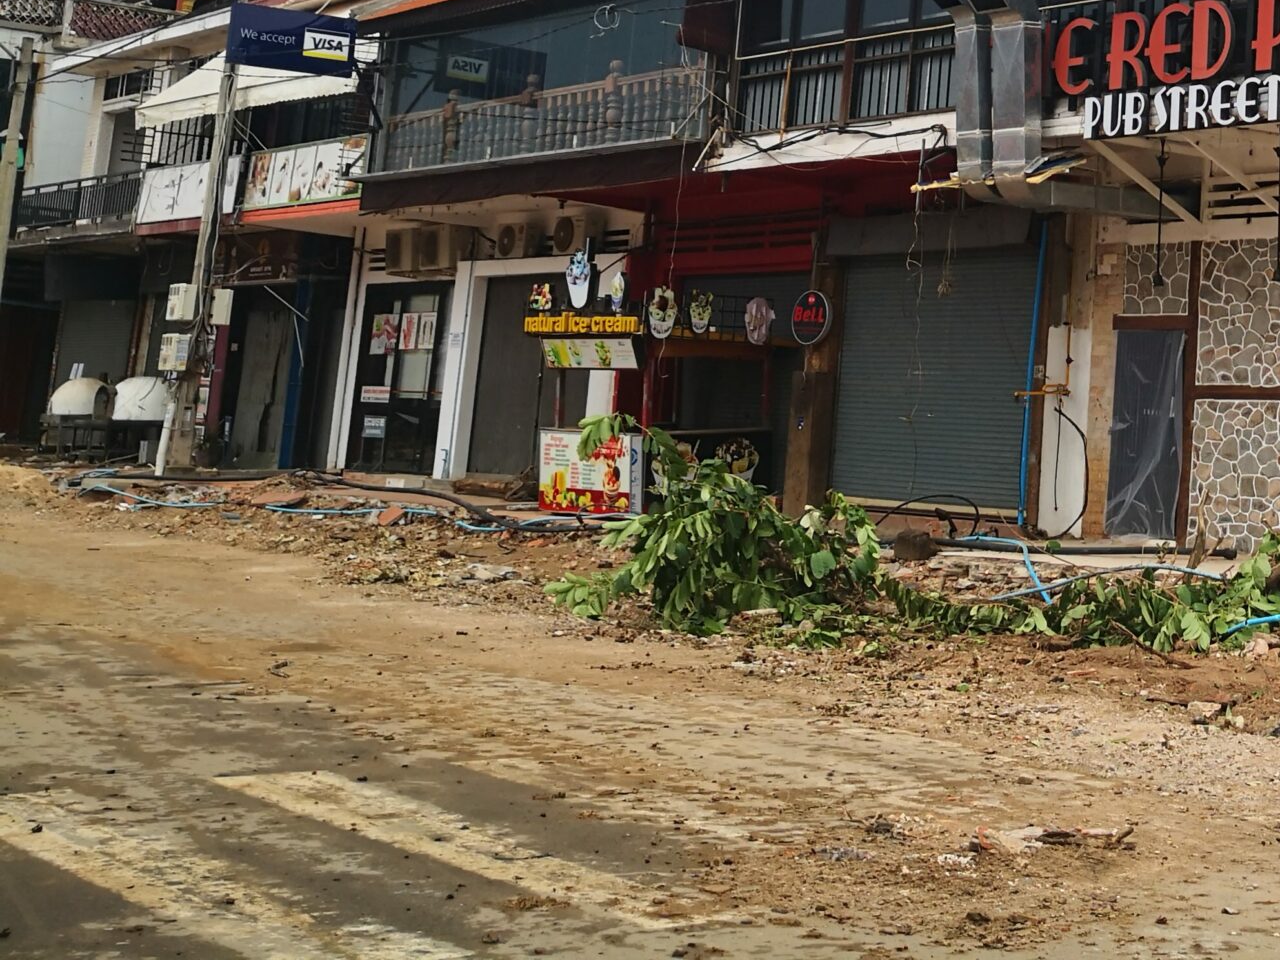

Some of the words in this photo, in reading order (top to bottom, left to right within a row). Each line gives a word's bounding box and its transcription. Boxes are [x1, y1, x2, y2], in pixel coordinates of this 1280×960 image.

[240, 27, 258, 39] We
[260, 31, 296, 46] accept
[311, 37, 343, 52] VISA
[1106, 0, 1232, 90] RED
[1083, 91, 1146, 139] PUB
[524, 311, 566, 333] natural
[567, 311, 590, 333] ice
[590, 316, 637, 333] cream
